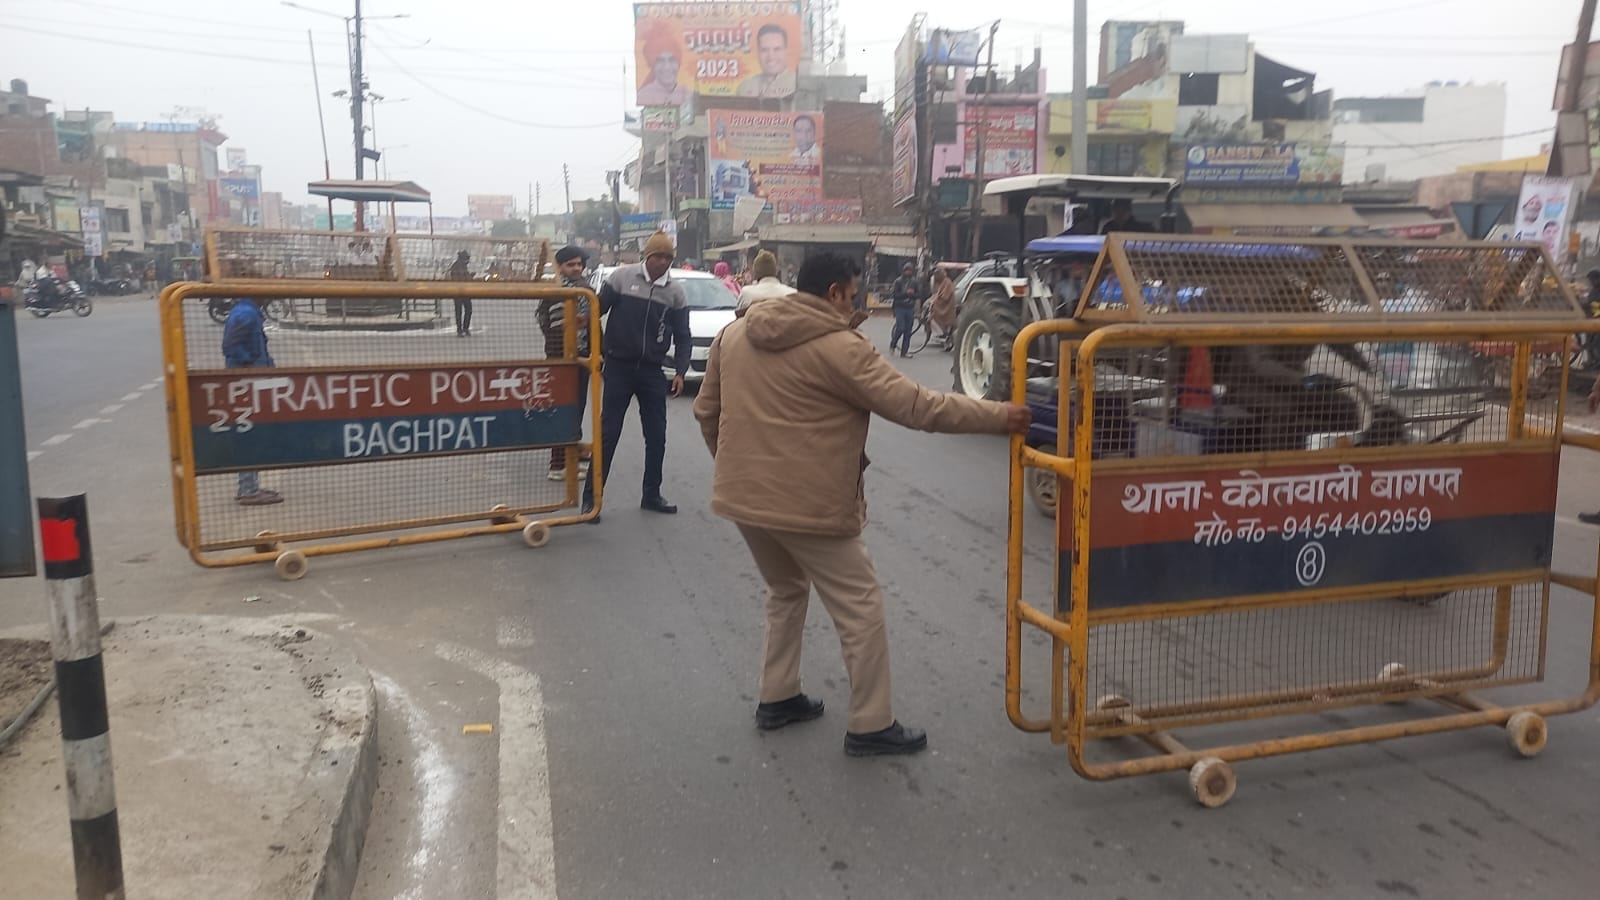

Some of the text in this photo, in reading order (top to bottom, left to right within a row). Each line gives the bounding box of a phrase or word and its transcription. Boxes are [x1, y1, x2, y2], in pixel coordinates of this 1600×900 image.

[696, 59, 739, 78] 2023
[243, 373, 411, 414] TRAFFIC
[431, 367, 551, 405] POLICE
[207, 406, 254, 433] 23
[343, 415, 496, 458] BAGHPAT
[1121, 465, 1462, 514] थाना- कोतवाली बागपत
